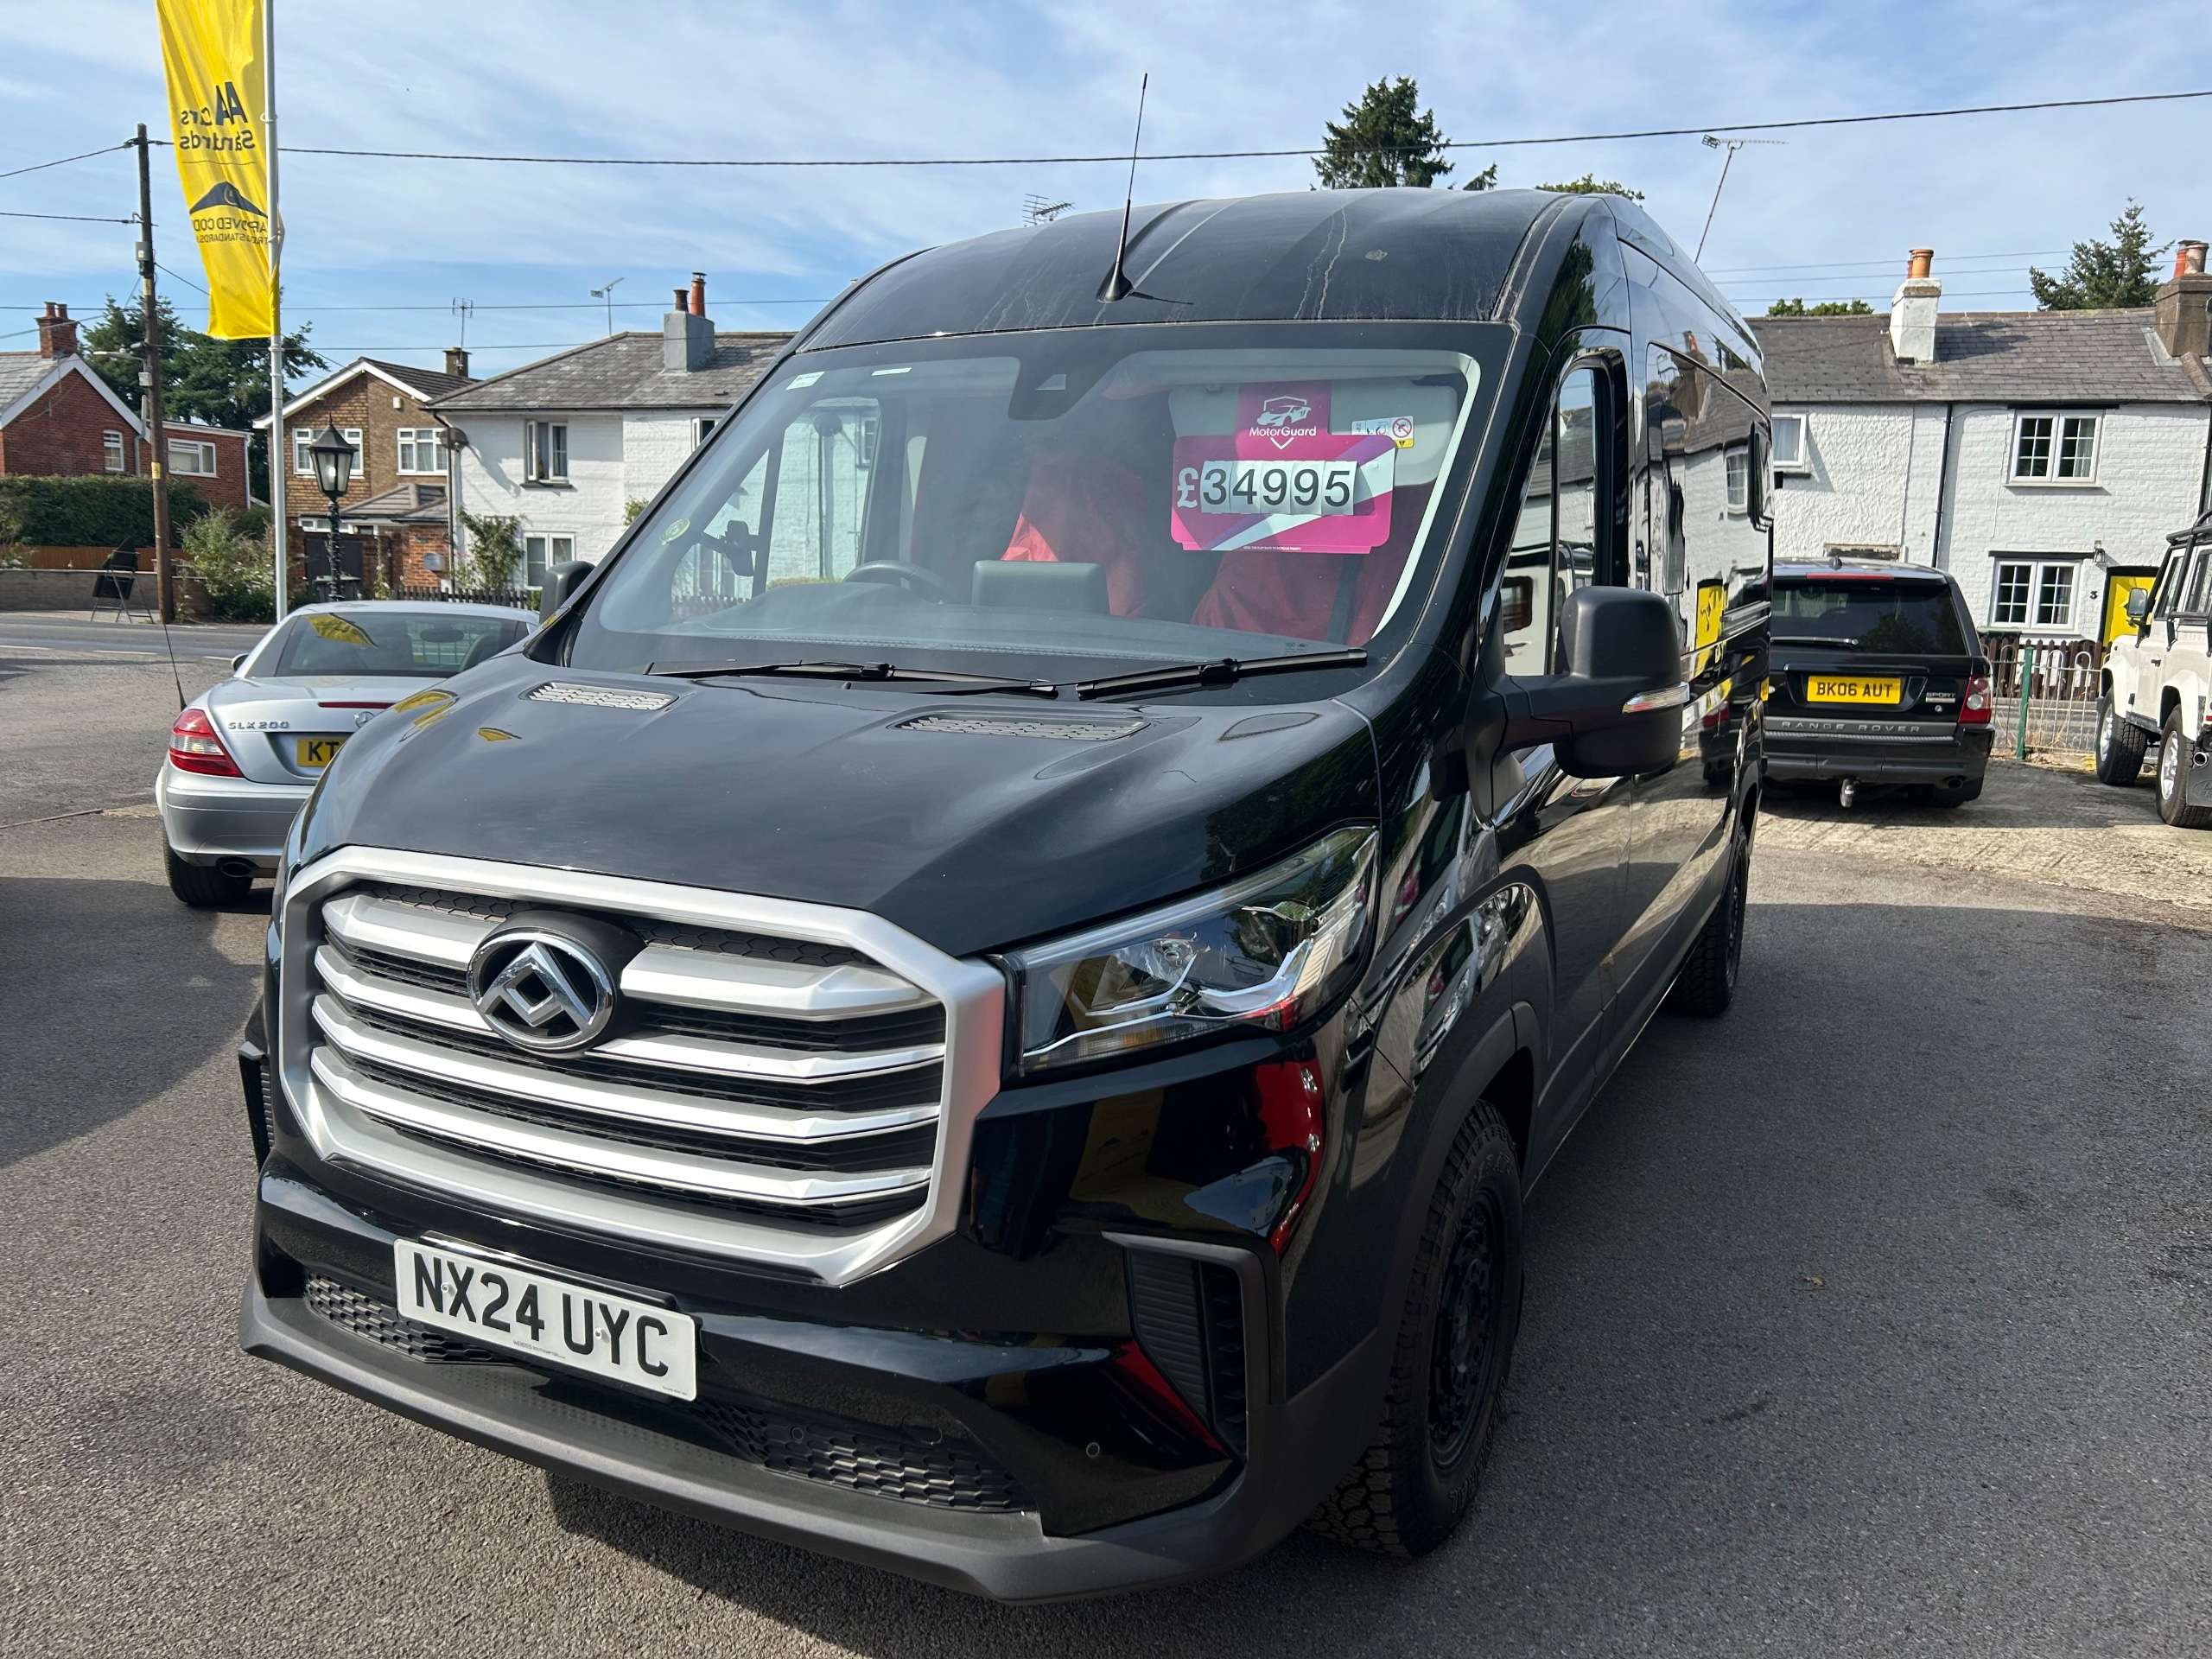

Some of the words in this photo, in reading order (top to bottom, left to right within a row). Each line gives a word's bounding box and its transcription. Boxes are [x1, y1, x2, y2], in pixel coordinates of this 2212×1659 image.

[1249, 426, 1317, 436] MotorGuard
[2089, 590, 2098, 600] 3
[1816, 683, 1857, 696] BK06
[1862, 683, 1893, 698] AUT
[1782, 721, 1846, 730] RANGE
[1858, 724, 1920, 733] ROVER
[308, 741, 340, 762] KT
[413, 1251, 544, 1342] NX24
[563, 1293, 669, 1377] UYC
